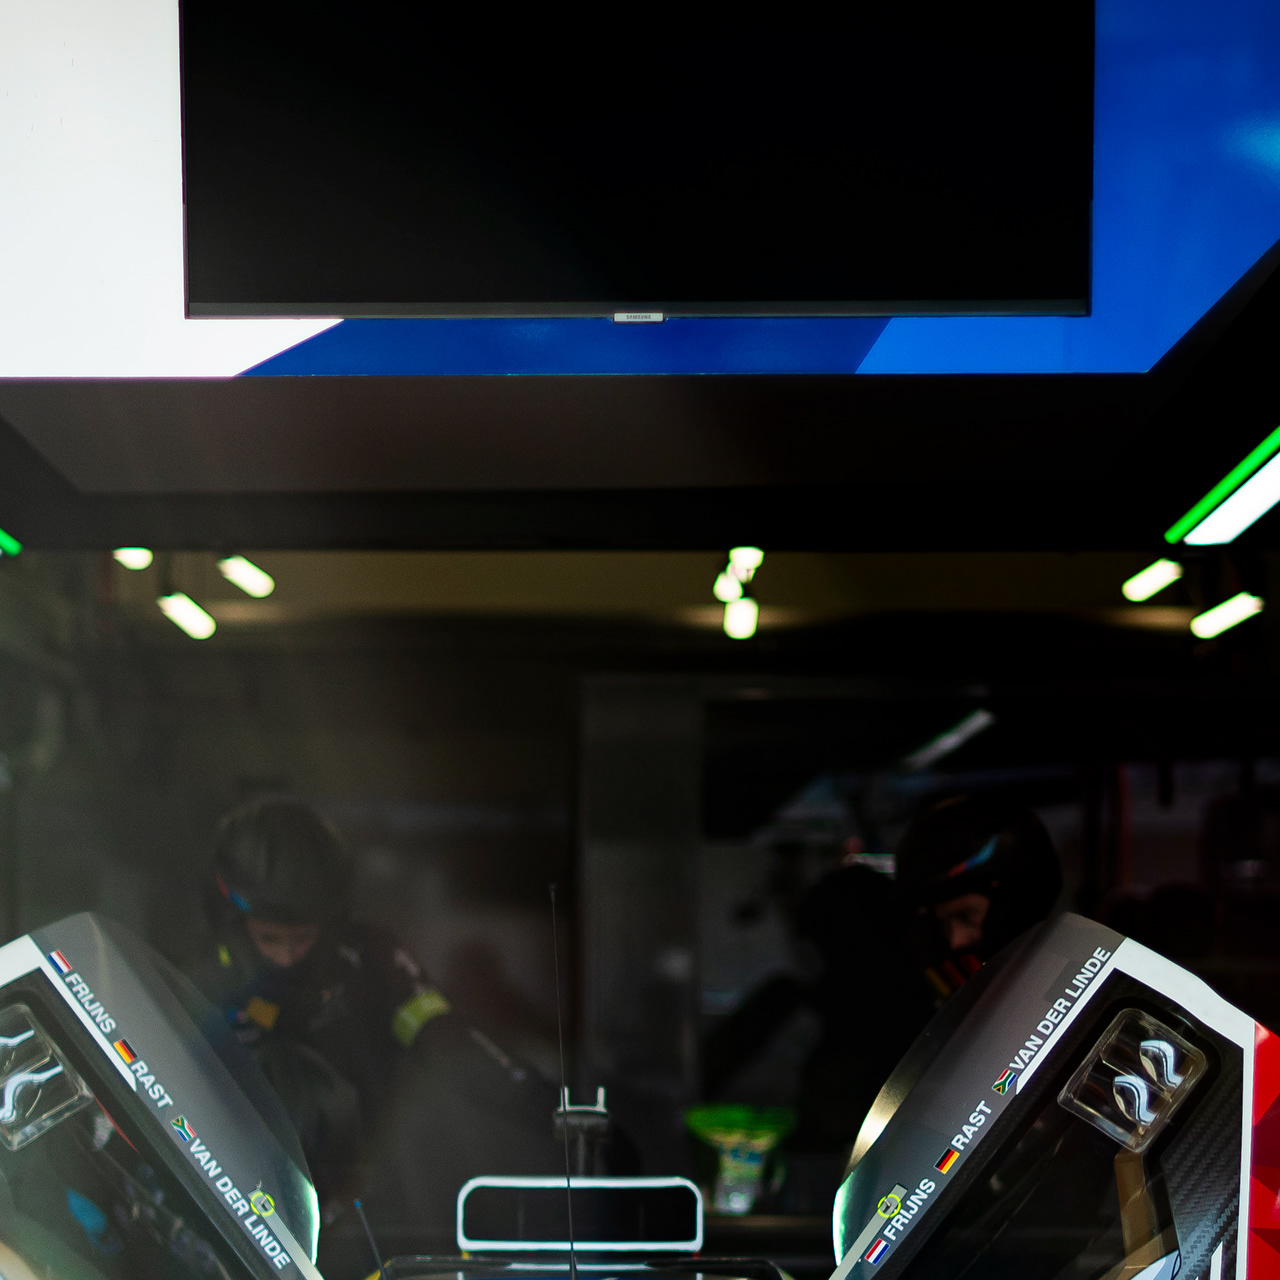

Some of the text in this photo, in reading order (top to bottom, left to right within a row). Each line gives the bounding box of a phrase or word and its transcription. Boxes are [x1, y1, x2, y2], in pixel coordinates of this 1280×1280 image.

[63, 972, 292, 1271] FRIJNS RAST VAN DER LINDE
[882, 946, 1112, 1242] FRIJNS RAST VAN DER LINDE
